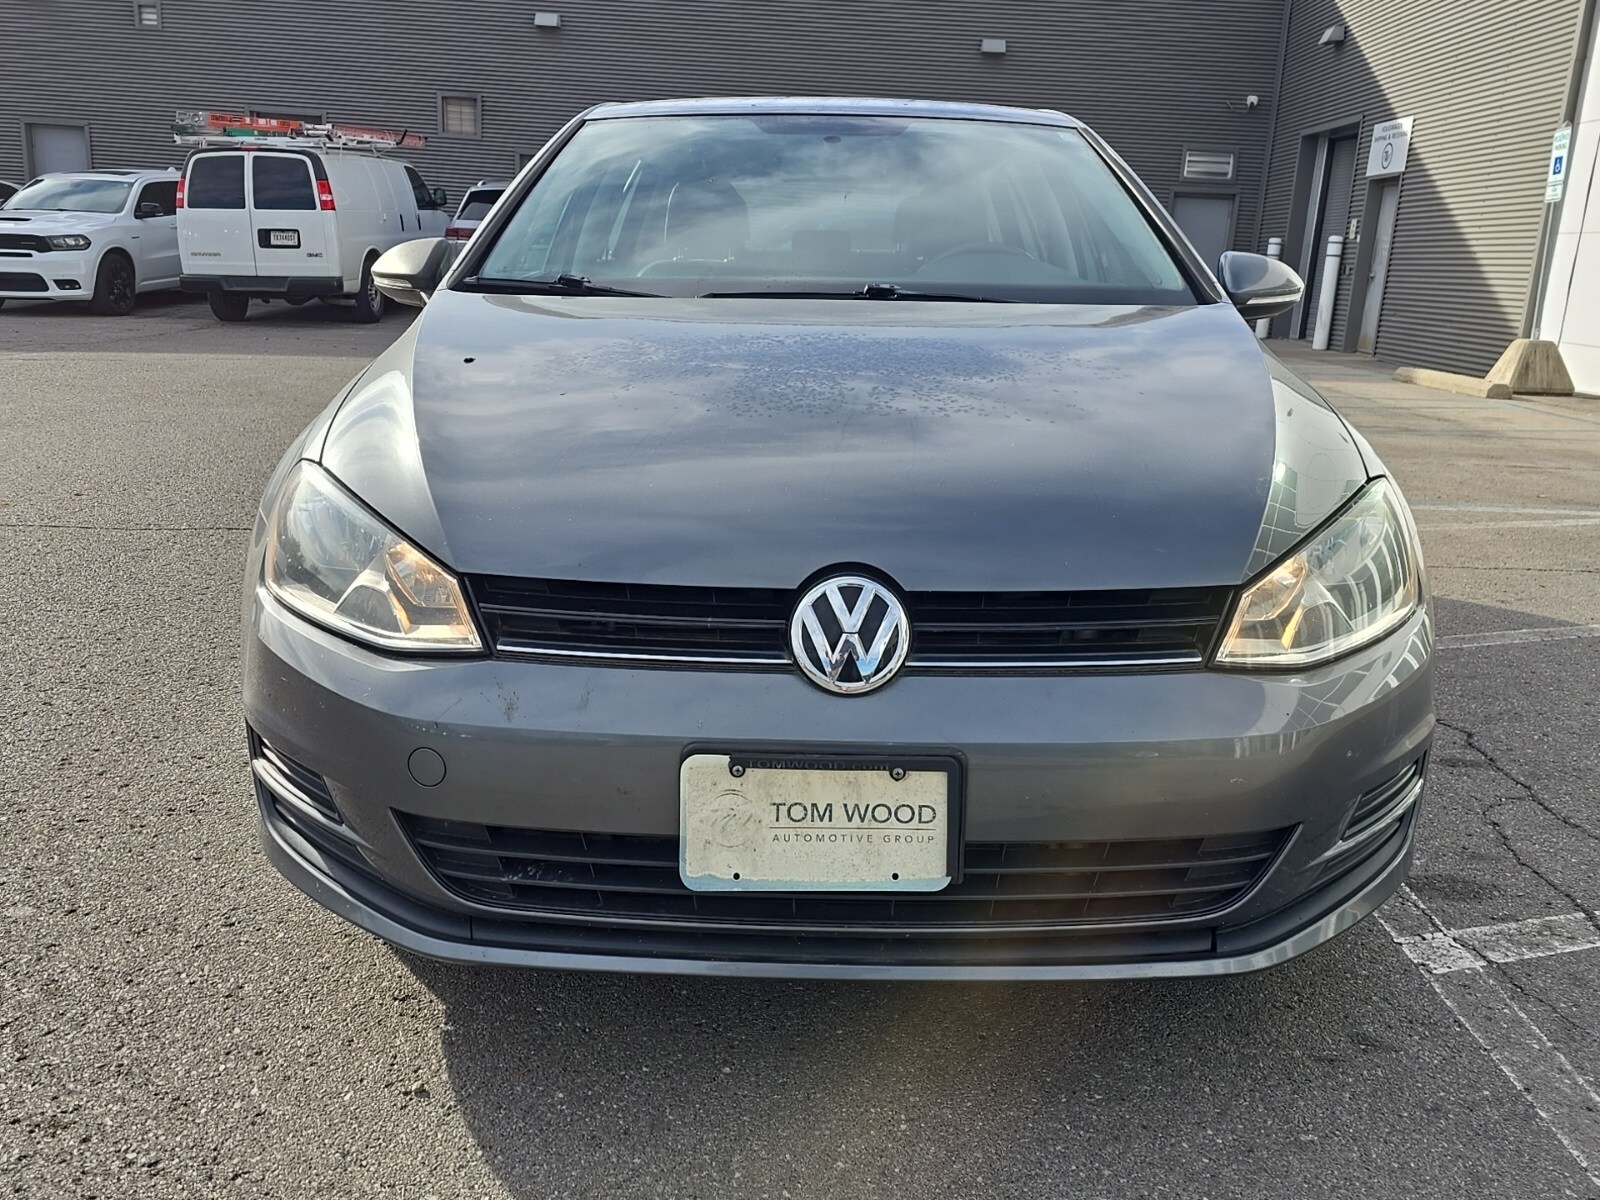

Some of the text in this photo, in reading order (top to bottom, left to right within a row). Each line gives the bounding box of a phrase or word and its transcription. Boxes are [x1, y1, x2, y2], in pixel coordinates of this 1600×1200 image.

[748, 759, 890, 770] TOMWOODcom
[770, 802, 937, 824] TOM WOOD
[772, 834, 935, 843] AUTOMOTIVE GROUP
